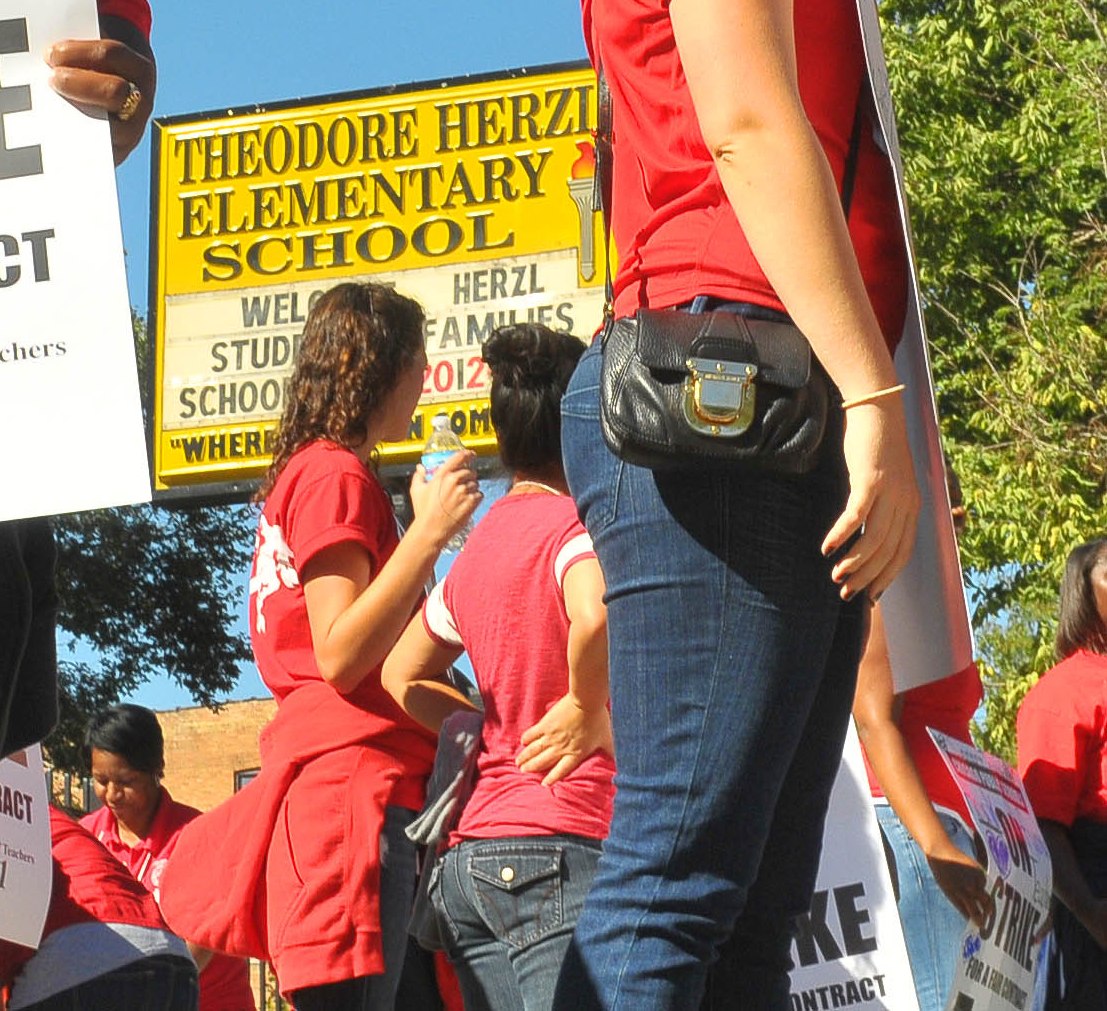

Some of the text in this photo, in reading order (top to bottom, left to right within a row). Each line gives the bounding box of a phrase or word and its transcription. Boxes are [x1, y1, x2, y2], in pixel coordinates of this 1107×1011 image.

[175, 106, 419, 185] THEODORE
[177, 147, 553, 240] ELEMENTARY
[202, 210, 515, 283] SCHOOL
[453, 263, 545, 306] HERZL
[3, 843, 35, 865] Teachers
